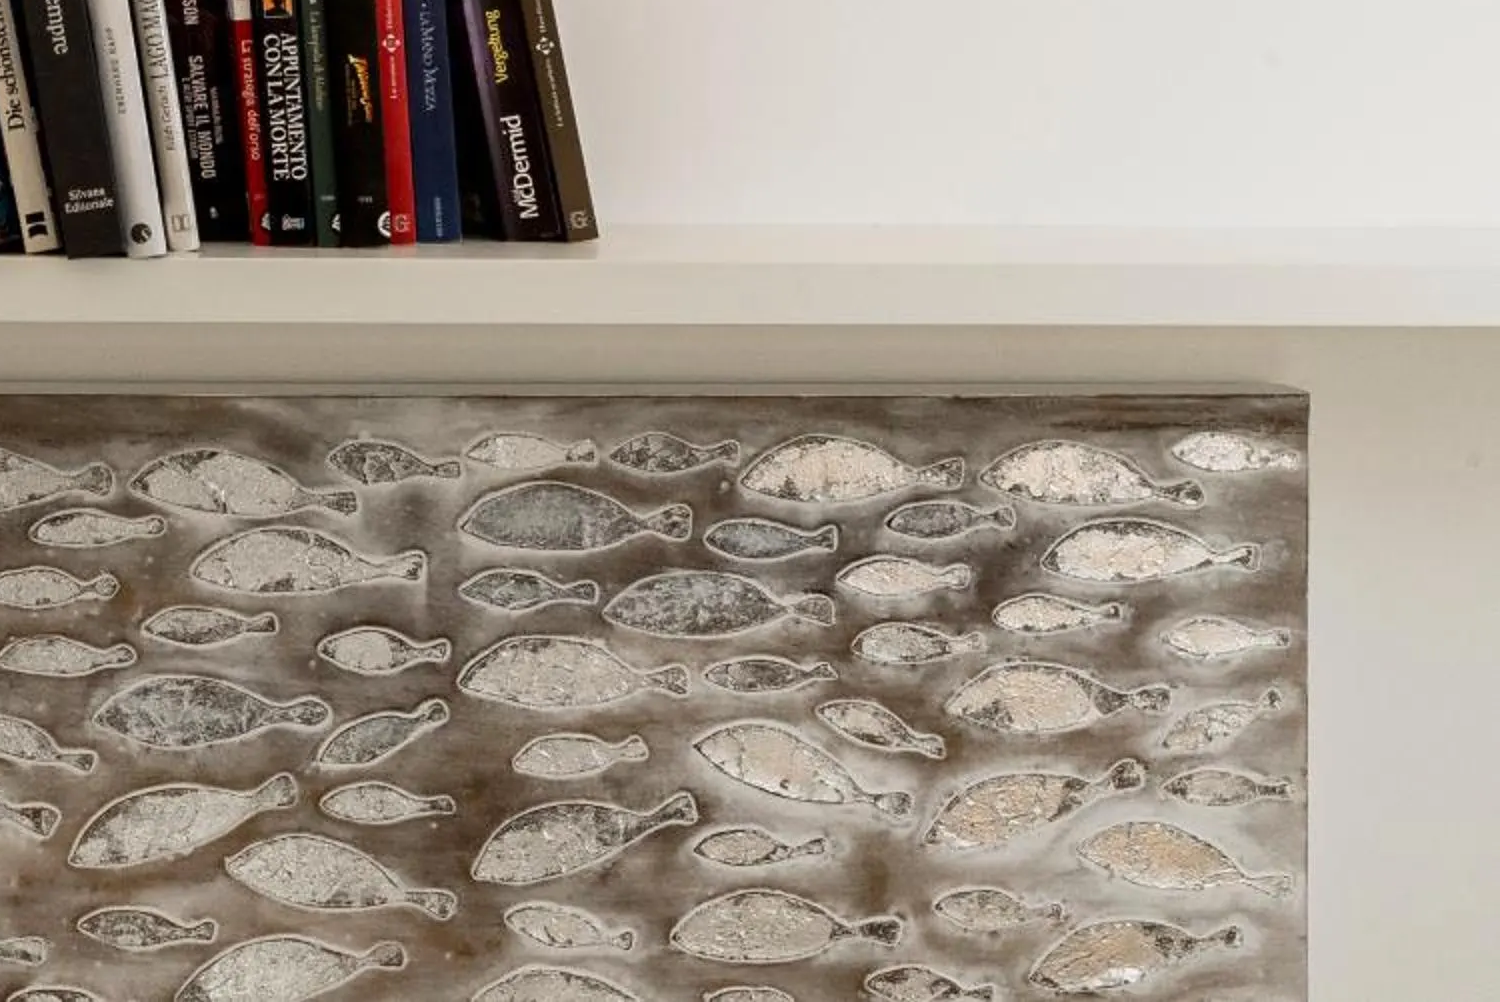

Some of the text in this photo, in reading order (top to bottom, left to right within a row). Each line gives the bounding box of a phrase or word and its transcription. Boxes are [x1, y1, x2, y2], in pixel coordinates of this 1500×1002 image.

[147, 32, 168, 80] LAGO
[241, 39, 253, 54] La
[485, 9, 509, 85] Vergeltung
[188, 54, 210, 110] SALVARE
[263, 33, 291, 182] CON LA MORTE
[280, 33, 308, 181] APPUNTAMENTO
[5, 99, 26, 132] Die
[195, 114, 211, 127] IL
[198, 130, 217, 179] MONDO
[500, 114, 541, 219] McDermid
